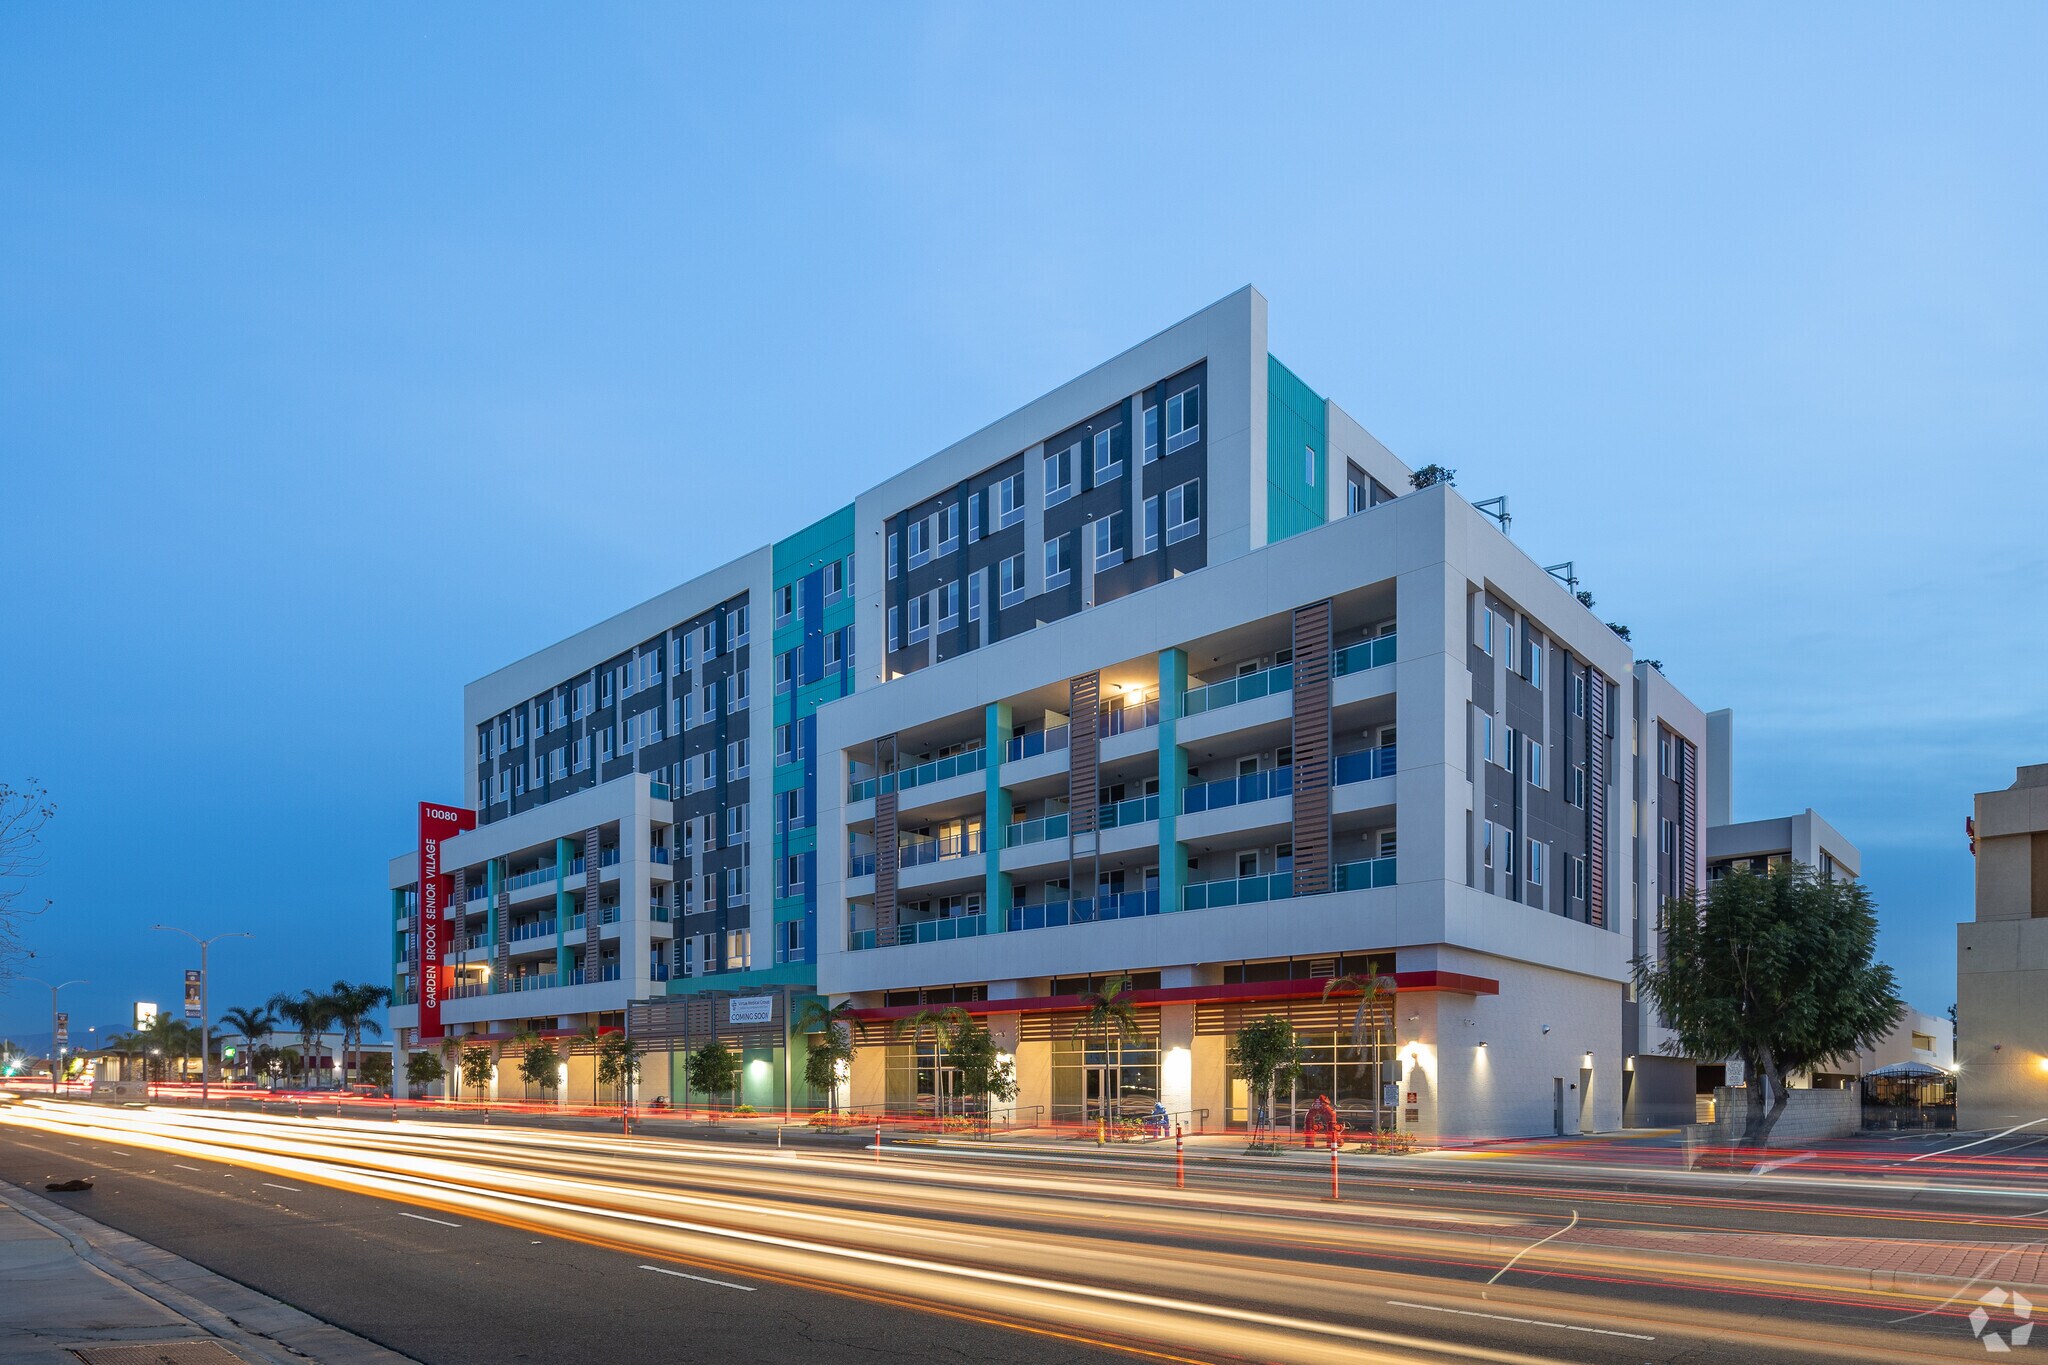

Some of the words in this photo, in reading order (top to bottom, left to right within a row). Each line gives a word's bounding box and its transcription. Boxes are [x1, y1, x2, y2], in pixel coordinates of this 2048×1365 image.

[425, 807, 458, 822] 10080
[426, 838, 436, 879] VILLAGE
[426, 883, 436, 920] SENIOR
[426, 923, 436, 961] BROOK
[426, 965, 436, 1008] GARDEN
[731, 1013, 754, 1021] COMING
[754, 1012, 769, 1020] SOON
